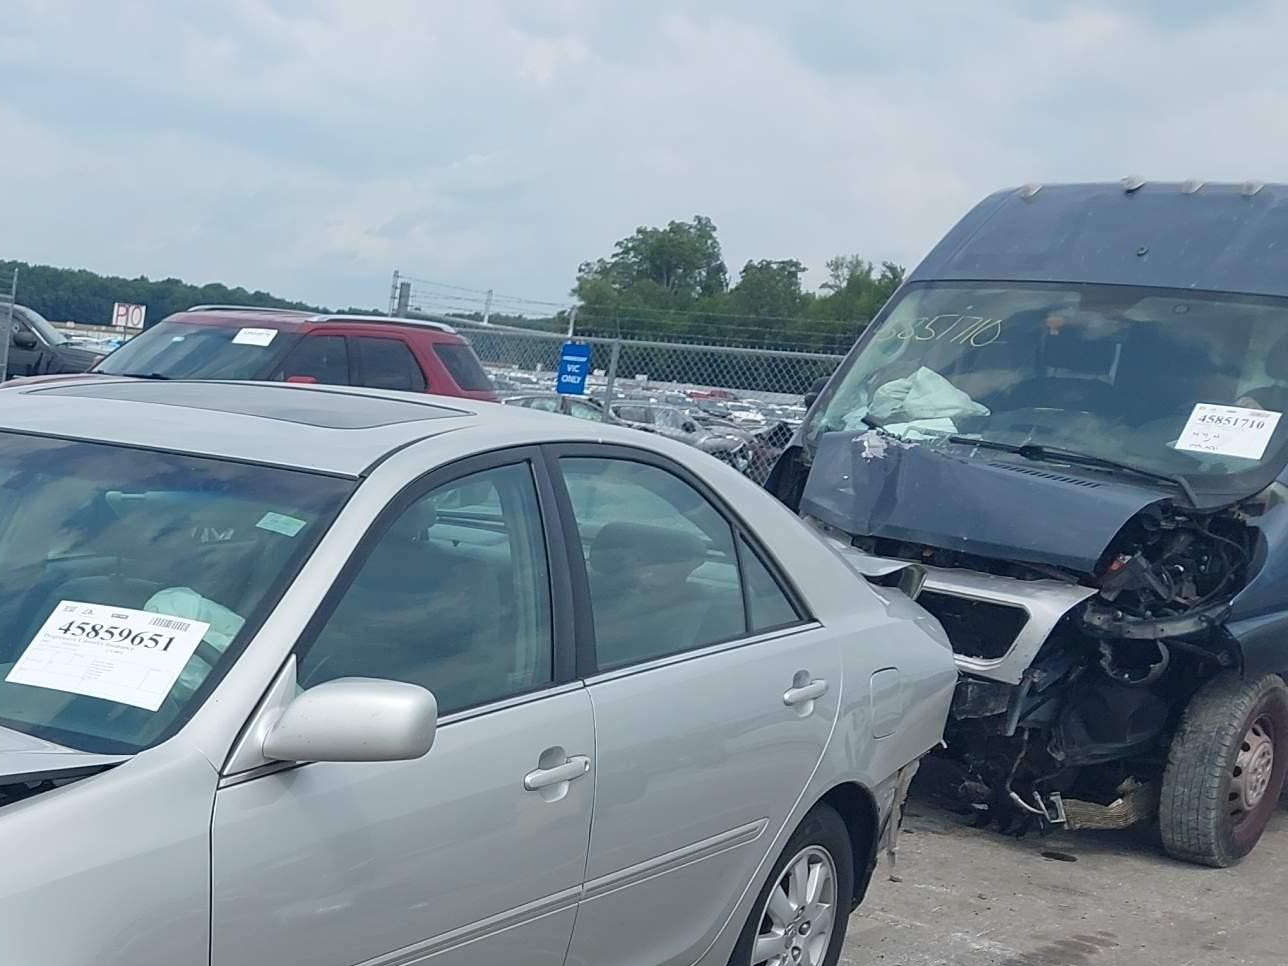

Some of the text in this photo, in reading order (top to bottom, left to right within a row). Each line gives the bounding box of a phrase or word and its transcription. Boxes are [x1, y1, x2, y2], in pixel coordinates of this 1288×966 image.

[566, 364, 581, 373] VIC
[560, 374, 582, 384] ONLY
[1197, 414, 1265, 430] 45851710
[57, 620, 176, 652] 45859651
